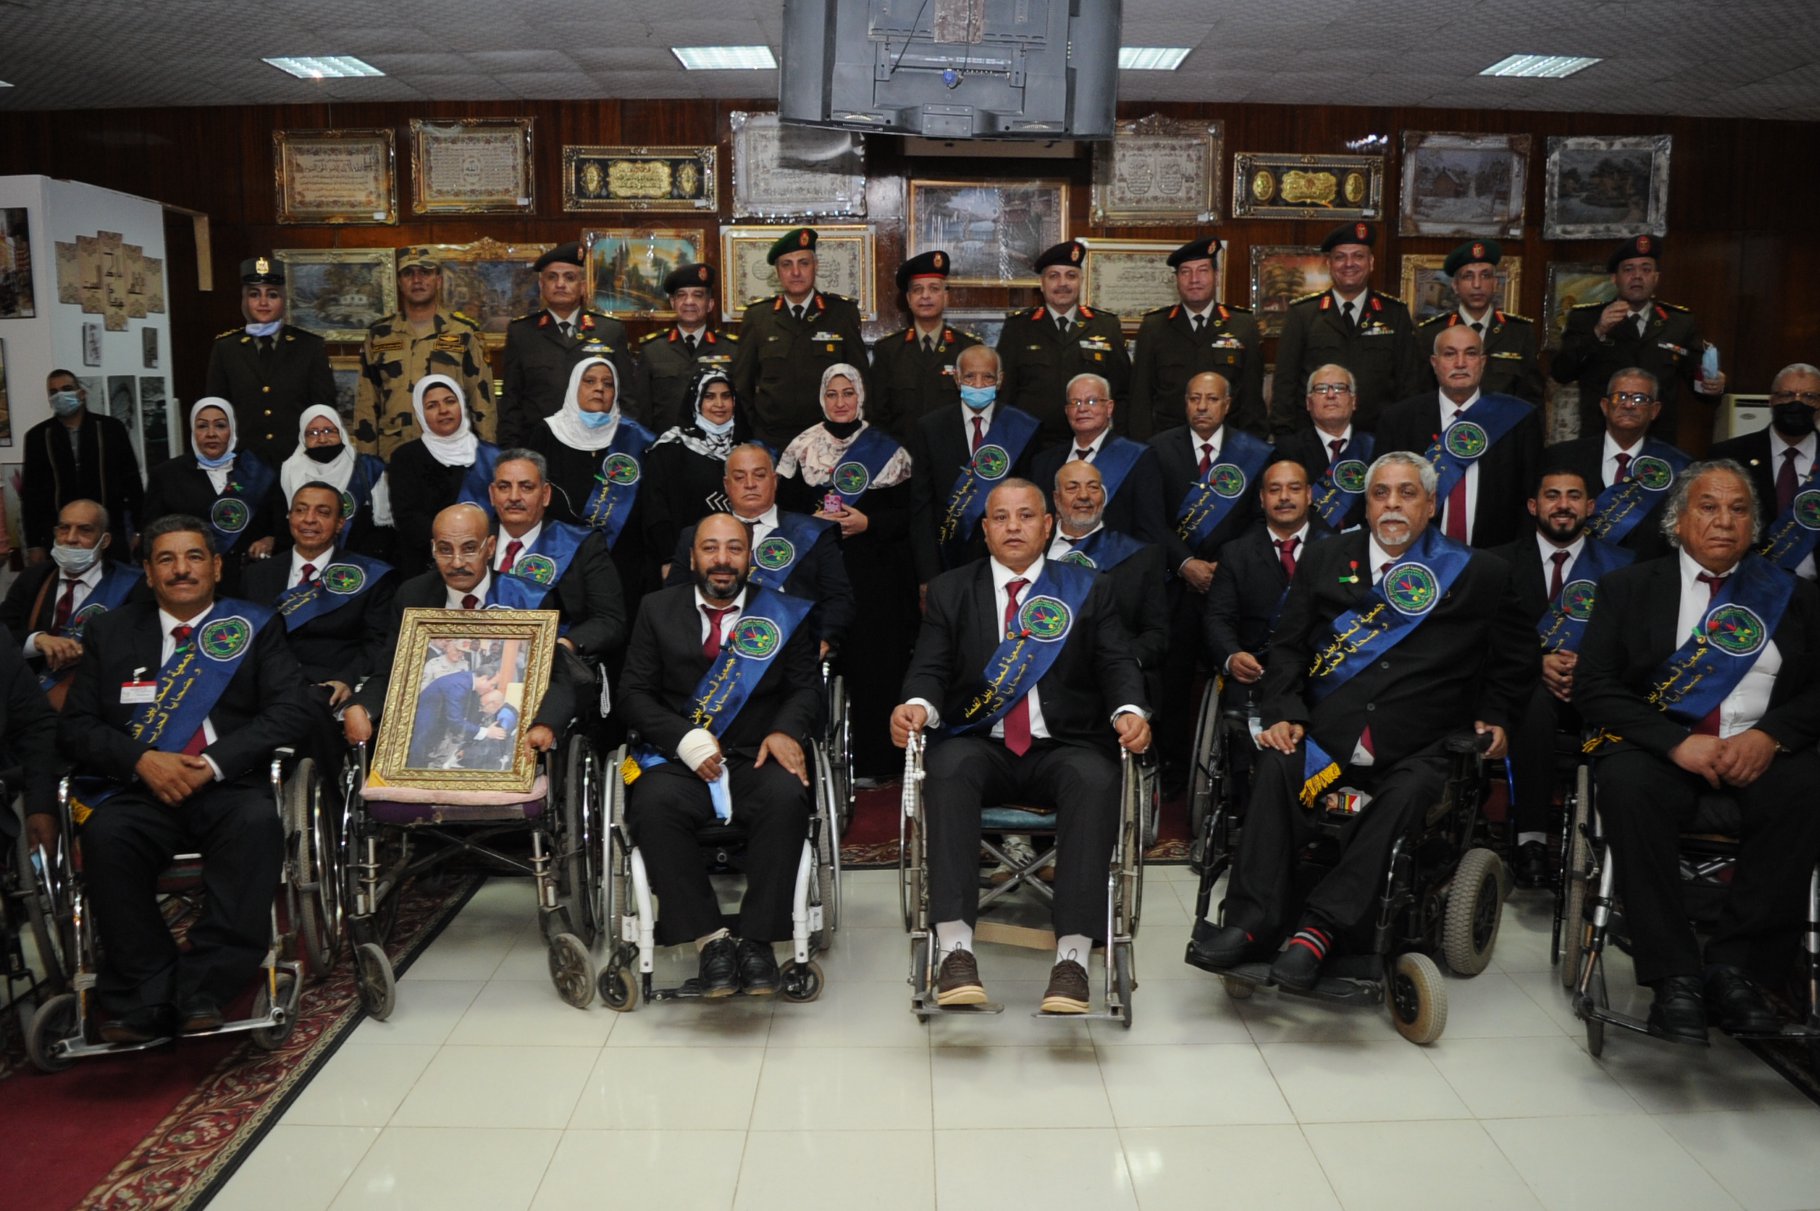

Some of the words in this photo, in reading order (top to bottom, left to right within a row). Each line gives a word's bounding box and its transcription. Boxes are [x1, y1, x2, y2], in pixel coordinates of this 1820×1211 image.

[1357, 604, 1385, 623] جمعية
[1002, 640, 1024, 663] جمعية
[1344, 630, 1379, 652] ضحايا
[166, 653, 195, 678] جمعية
[715, 658, 735, 681] جمعية
[1320, 652, 1344, 676] الحرب
[983, 663, 1010, 704] المحاربين
[1002, 663, 1027, 694] ضحايا
[164, 678, 194, 709] ضحايا
[148, 712, 168, 743] الحرب
